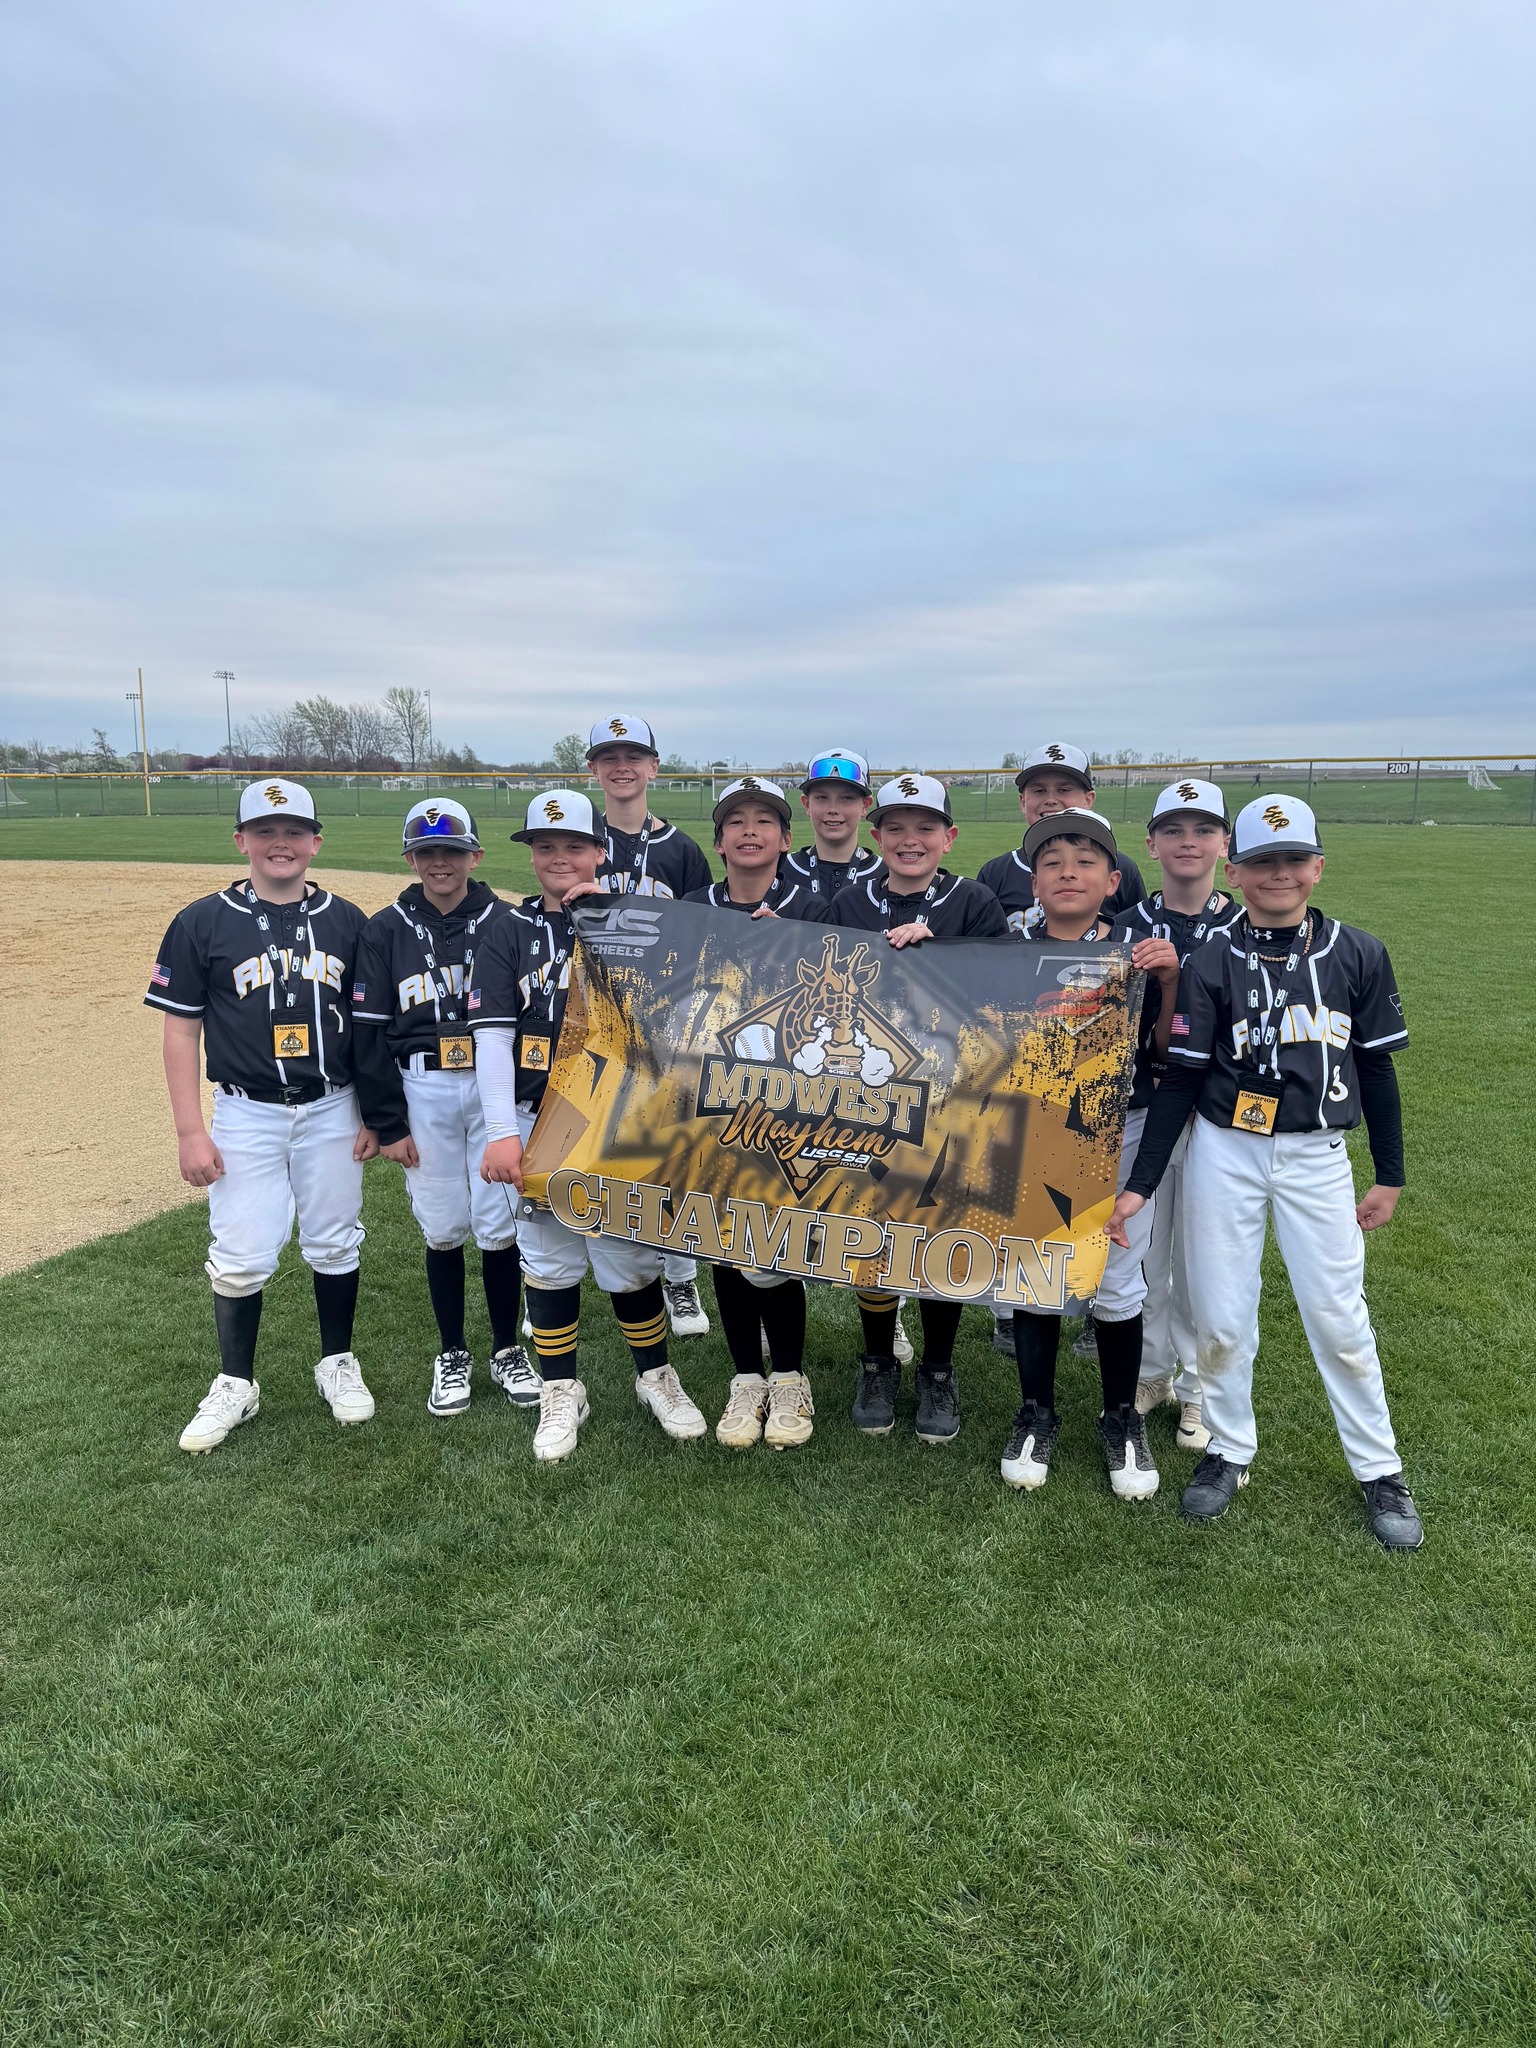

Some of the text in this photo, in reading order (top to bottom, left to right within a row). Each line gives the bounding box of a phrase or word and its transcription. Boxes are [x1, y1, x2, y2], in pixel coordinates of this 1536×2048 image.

[1388, 763, 1409, 774] 200
[704, 1060, 922, 1133] MIDWEST
[720, 1100, 894, 1160] Mayhem
[840, 1161, 864, 1169] IOWA
[547, 1168, 1075, 1310] CHAMPION
